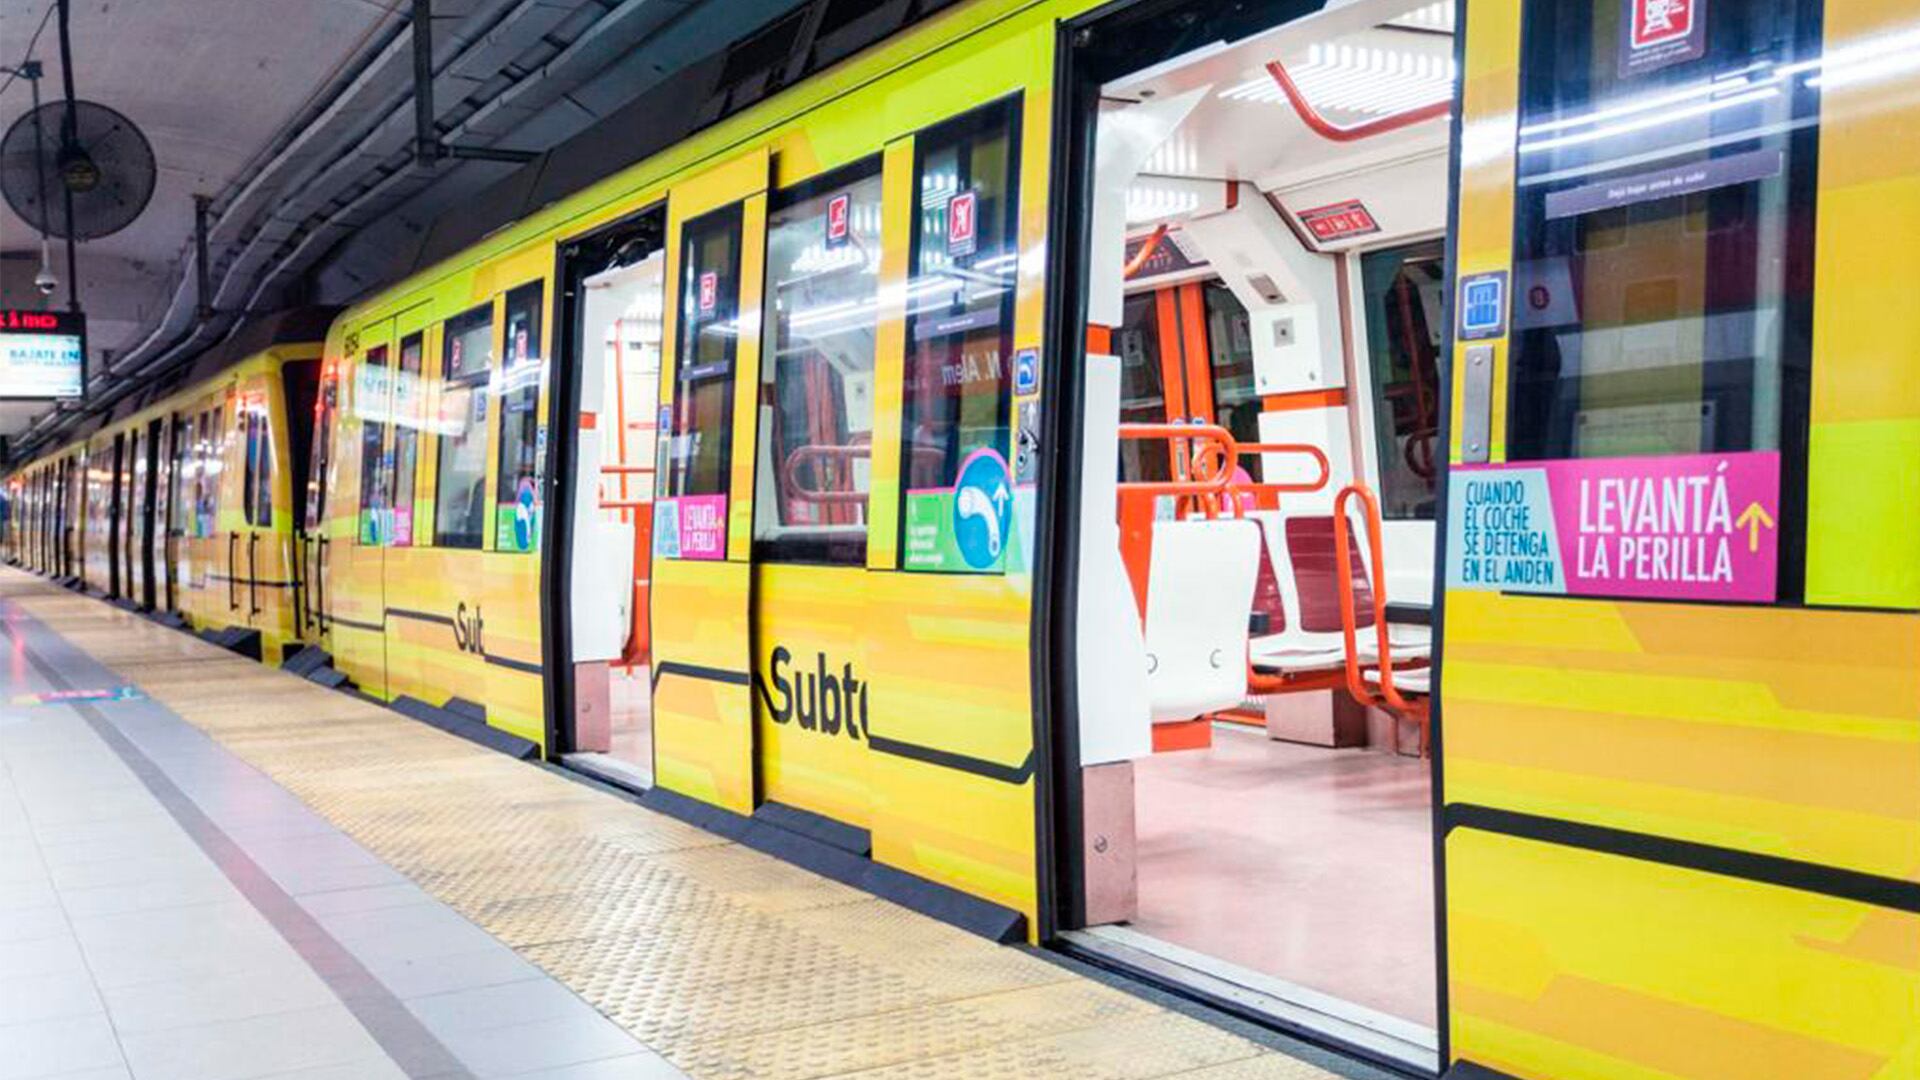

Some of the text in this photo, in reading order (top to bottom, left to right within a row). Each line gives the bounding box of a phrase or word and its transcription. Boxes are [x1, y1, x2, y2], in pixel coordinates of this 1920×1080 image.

[1466, 480, 1524, 506] CUANDO
[1579, 460, 1732, 534] LEVANTÁ
[1465, 506, 1530, 531] EL COCHE
[1464, 531, 1549, 557] SE DETENGA
[1463, 558, 1554, 585] EN EL ANDEN
[1577, 535, 1733, 583] LA PERILLA
